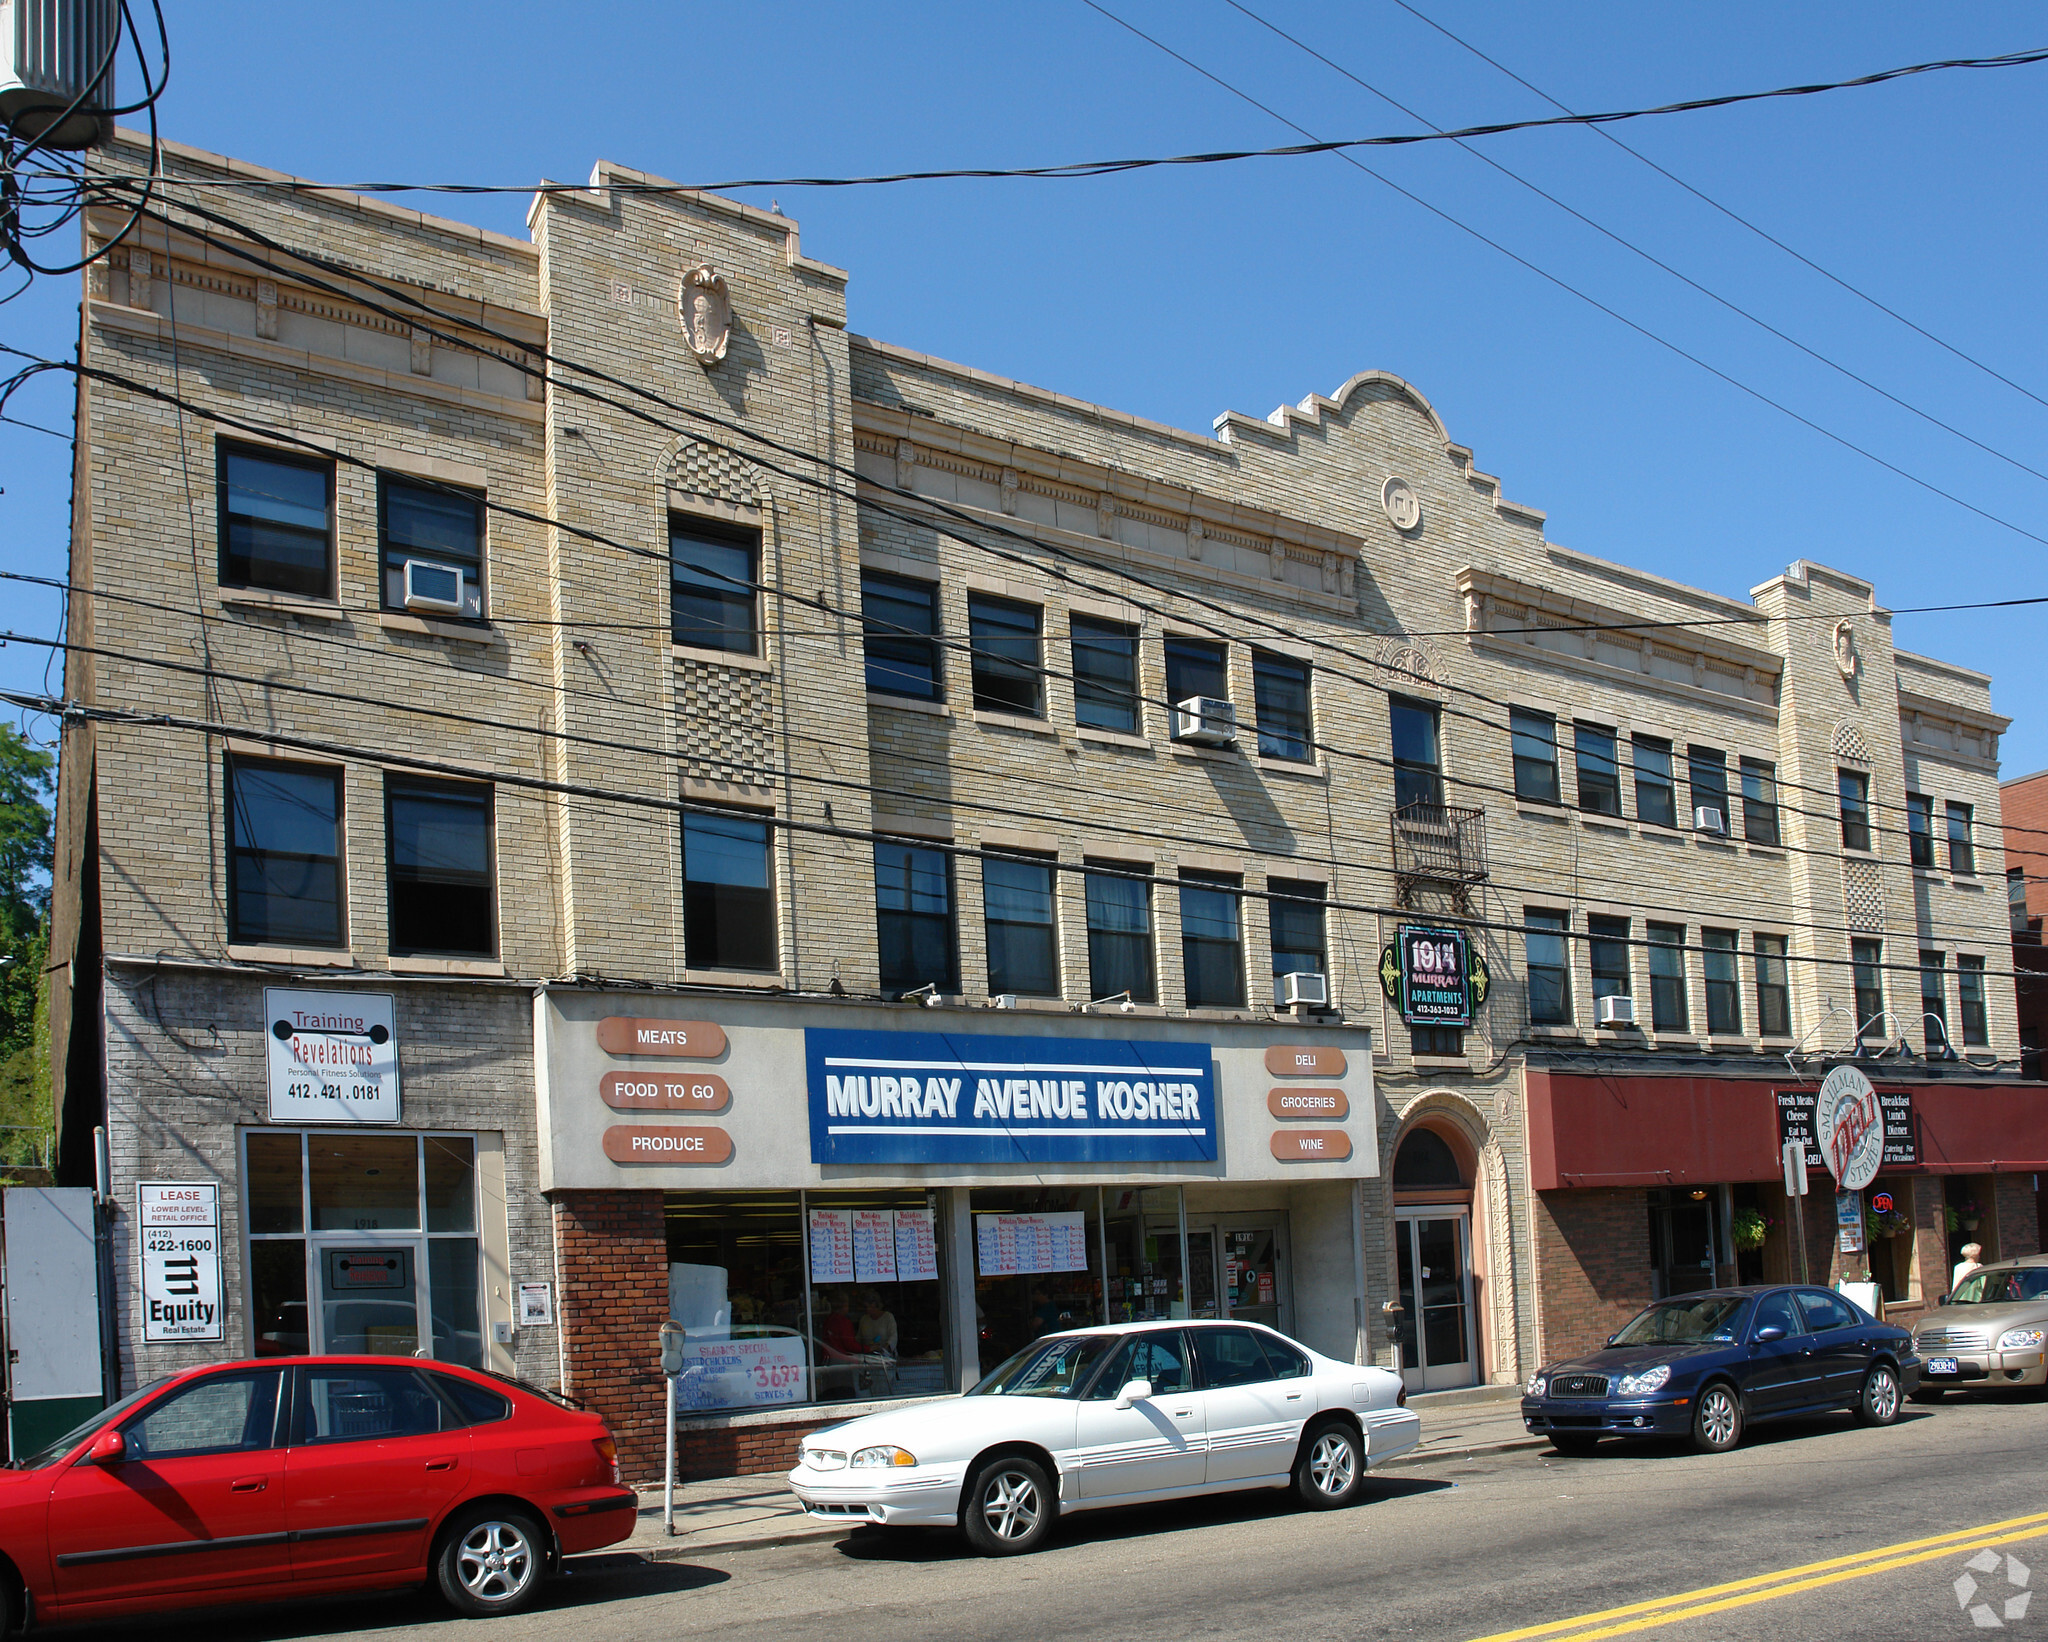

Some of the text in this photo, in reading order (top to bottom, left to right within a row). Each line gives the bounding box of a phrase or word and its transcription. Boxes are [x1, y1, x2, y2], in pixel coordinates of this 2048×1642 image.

[1412, 940, 1456, 973] 1914
[1412, 973, 1460, 988] MURRAY
[1411, 990, 1463, 1004] APARTMENTS
[1416, 1005, 1458, 1015] 412-363-1033
[292, 1011, 364, 1034] Training
[637, 1029, 687, 1045] MEATS
[293, 1036, 373, 1066] Revelations
[1295, 1054, 1317, 1066] DELI
[288, 1068, 382, 1079] Personal Fitness Solutions
[615, 1082, 714, 1099] FOOD TO GO
[826, 1074, 1201, 1121] MURRAY AVENUE KOSHER
[1281, 1096, 1336, 1108] GROCERIES
[1777, 1094, 1814, 1106] Fresh Meats
[1881, 1095, 1910, 1106] Breakfast
[1786, 1110, 1808, 1121] Cheese
[1887, 1109, 1907, 1120] Lunch
[1788, 1127, 1808, 1136] Eat In
[1887, 1124, 1908, 1135] Dinner
[632, 1136, 704, 1151] PRODUCE
[1299, 1138, 1324, 1150] WINE
[1801, 1136, 1813, 1145] Out
[1884, 1144, 1914, 1154] Catering For
[1884, 1153, 1892, 1162] All
[160, 1191, 200, 1200] LEASE
[1872, 1195, 1893, 1210] OPEN
[147, 1230, 172, 1239] (412)
[148, 1240, 212, 1251] 422-1600
[150, 1299, 215, 1326] Equity
[181, 1326, 206, 1334] Estate
